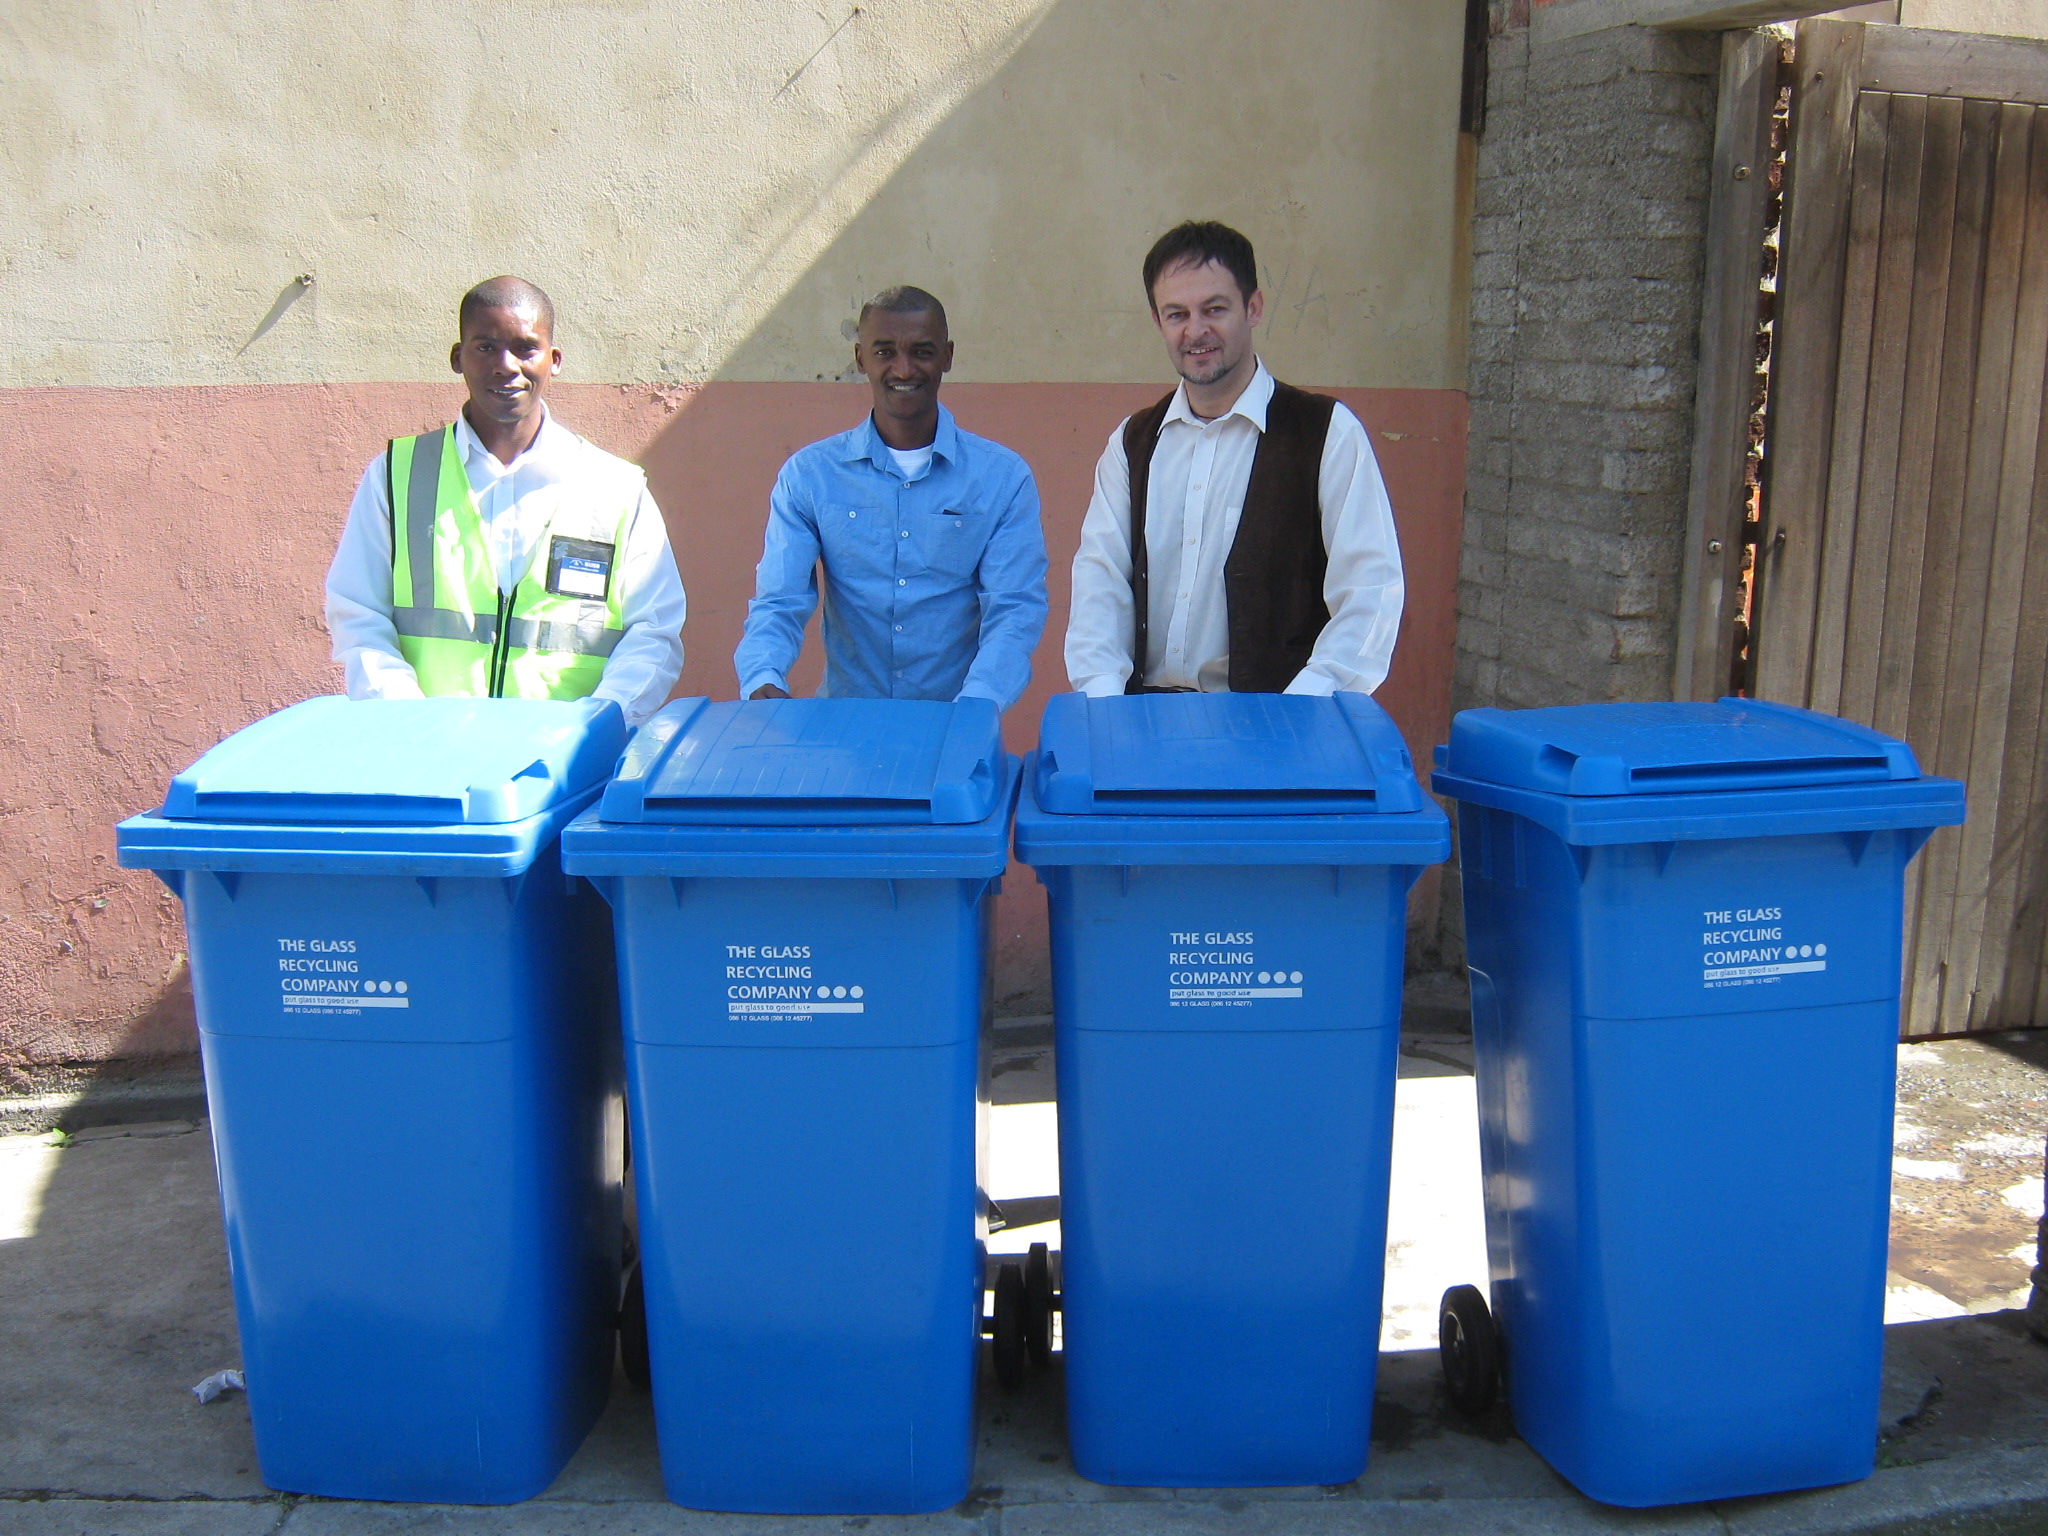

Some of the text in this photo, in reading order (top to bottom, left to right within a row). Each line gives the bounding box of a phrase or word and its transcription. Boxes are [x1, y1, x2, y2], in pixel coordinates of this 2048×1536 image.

[1704, 907, 1782, 924] THE GLASS
[1170, 932, 1254, 945] THE GLASS
[1703, 927, 1782, 945] RECYCLING
[278, 939, 357, 953] THE GLASS
[726, 945, 811, 959] THE GLASS
[1169, 952, 1254, 965] RECYCLING
[1704, 947, 1782, 966] COMPANY
[279, 959, 359, 973] RECYCLING
[726, 966, 812, 979] RECYCLING
[1719, 969, 1737, 977] glass
[1748, 967, 1766, 975] good
[1170, 971, 1254, 985] COMPANY
[281, 978, 360, 993] COMPANY
[727, 985, 813, 999] COMPANY
[327, 997, 345, 1005] good
[730, 1004, 743, 1012] put
[745, 1004, 764, 1012] glass
[776, 1004, 796, 1012] good
